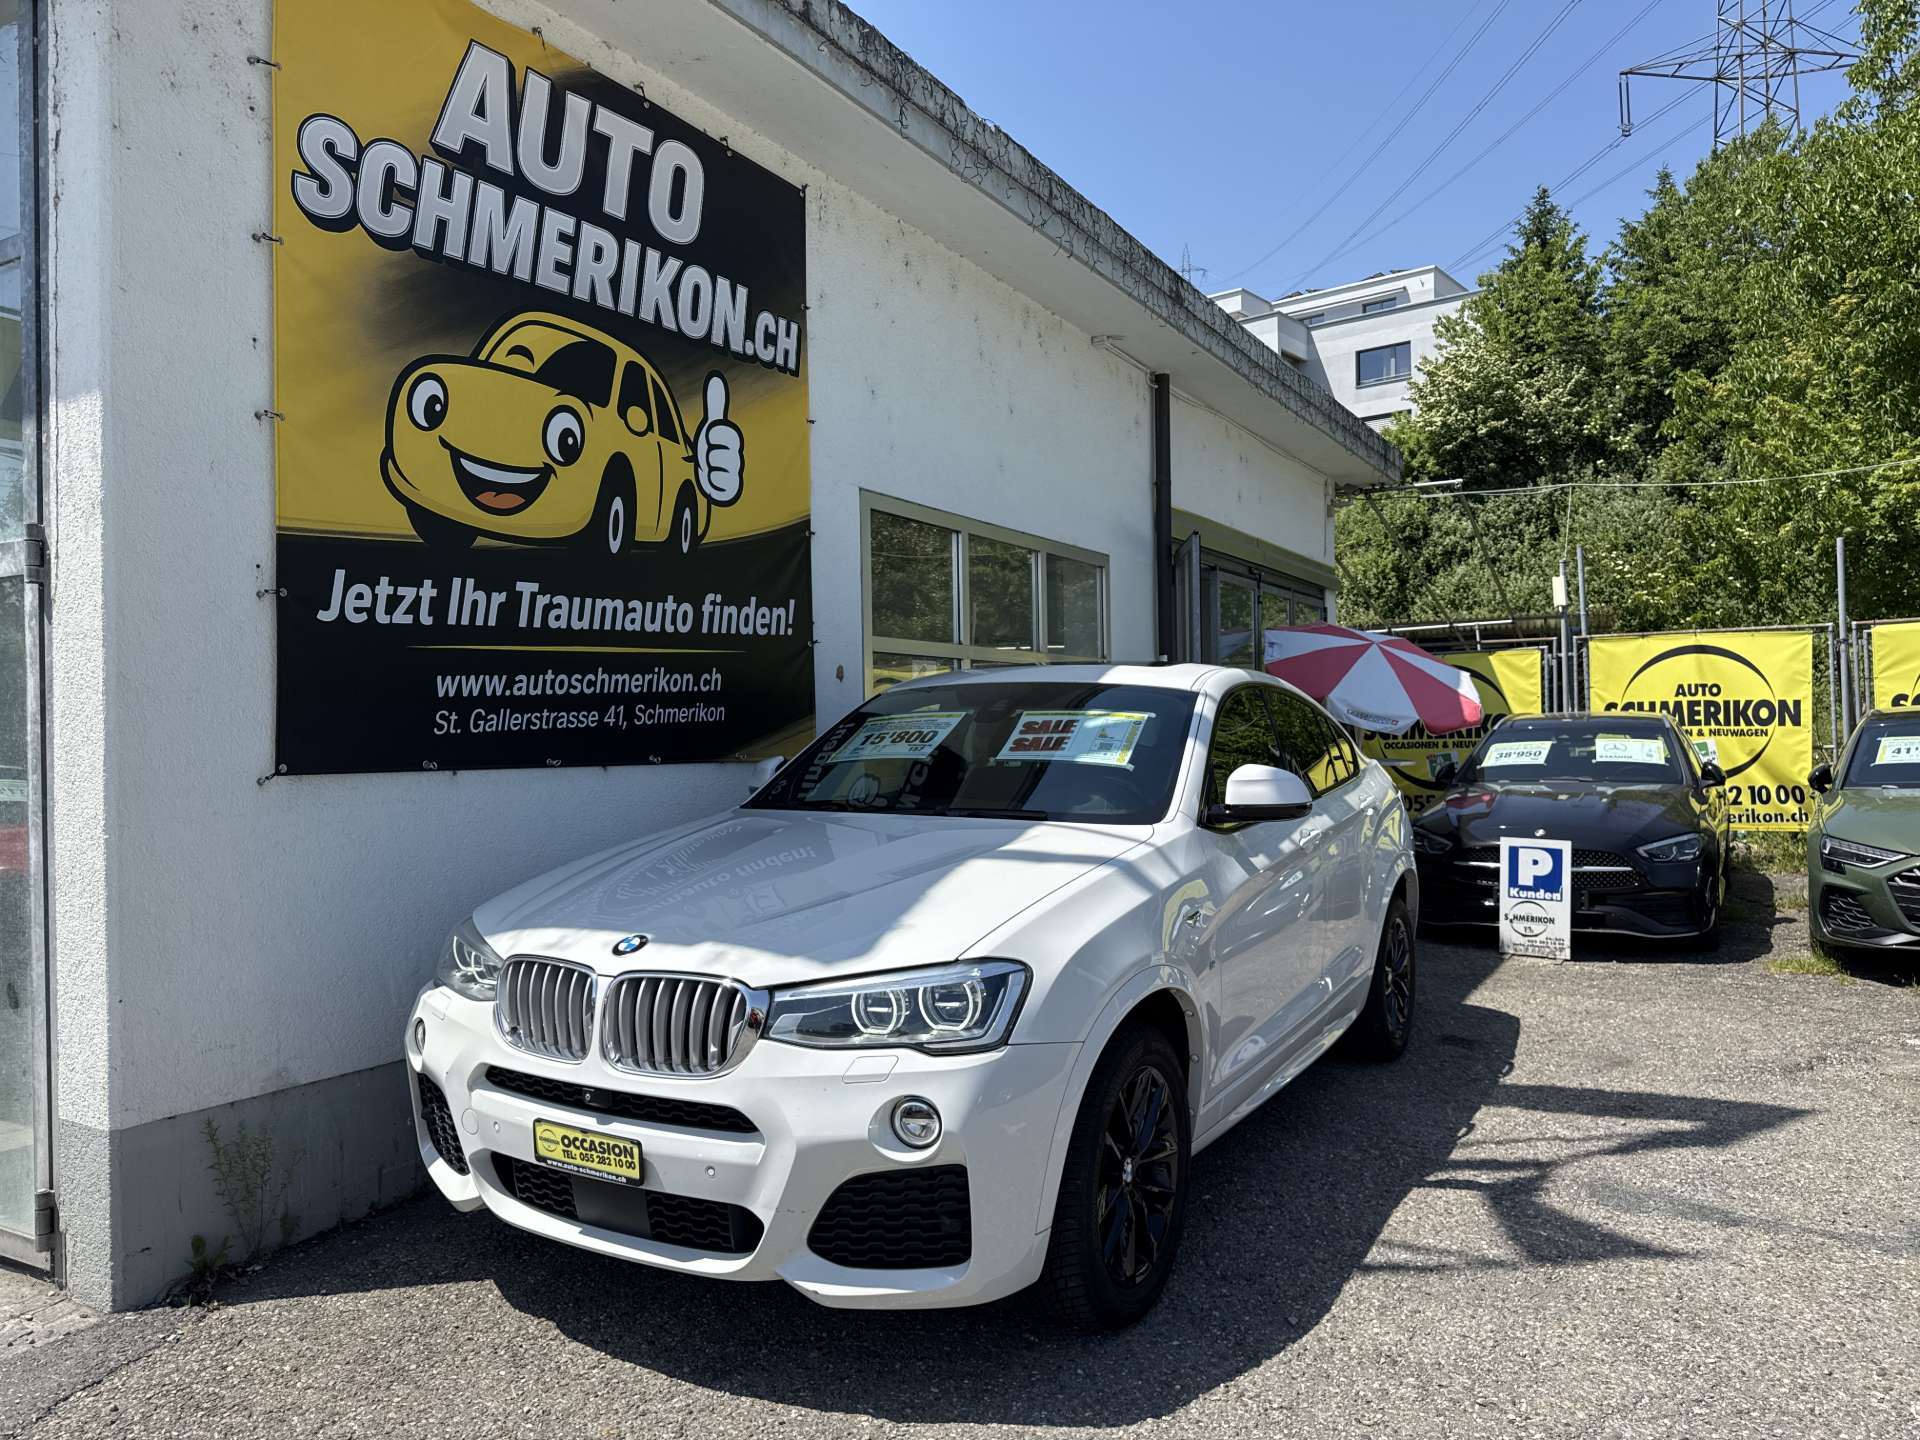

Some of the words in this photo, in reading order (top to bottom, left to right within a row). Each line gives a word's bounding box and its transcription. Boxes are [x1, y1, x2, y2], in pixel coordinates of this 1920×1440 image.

[431, 39, 705, 246] AUTO
[292, 115, 801, 372] SCHMERIKON.CH
[316, 568, 437, 626] Jetzt
[447, 577, 507, 628] Ihr
[515, 581, 694, 634] Traumauto
[700, 594, 796, 637] finden!
[435, 666, 723, 699] www.autoschmerikon.ch
[1675, 683, 1722, 697] AUTO
[433, 709, 462, 736] St.
[469, 705, 599, 735] Gallerstrasse
[603, 705, 628, 731] 41,
[633, 703, 726, 727] Schmerikon
[1019, 719, 1080, 735] SALE
[860, 729, 939, 747] 15'800
[1708, 728, 1769, 738] NEUWAGEN
[1009, 736, 1071, 752] SALE
[1383, 741, 1439, 750] OCCASIONEN
[1442, 741, 1449, 749] &
[1775, 785, 1806, 806] 00
[1727, 807, 1809, 824] erikon.ch
[1509, 887, 1561, 901] Kunden
[1504, 913, 1556, 925] SHMERIKON
[560, 1134, 635, 1160] OCCASION
[562, 1149, 577, 1160] TEL:
[579, 1152, 595, 1163] 055
[596, 1155, 612, 1166] 282
[614, 1158, 624, 1169] 10
[624, 1160, 636, 1170] 00
